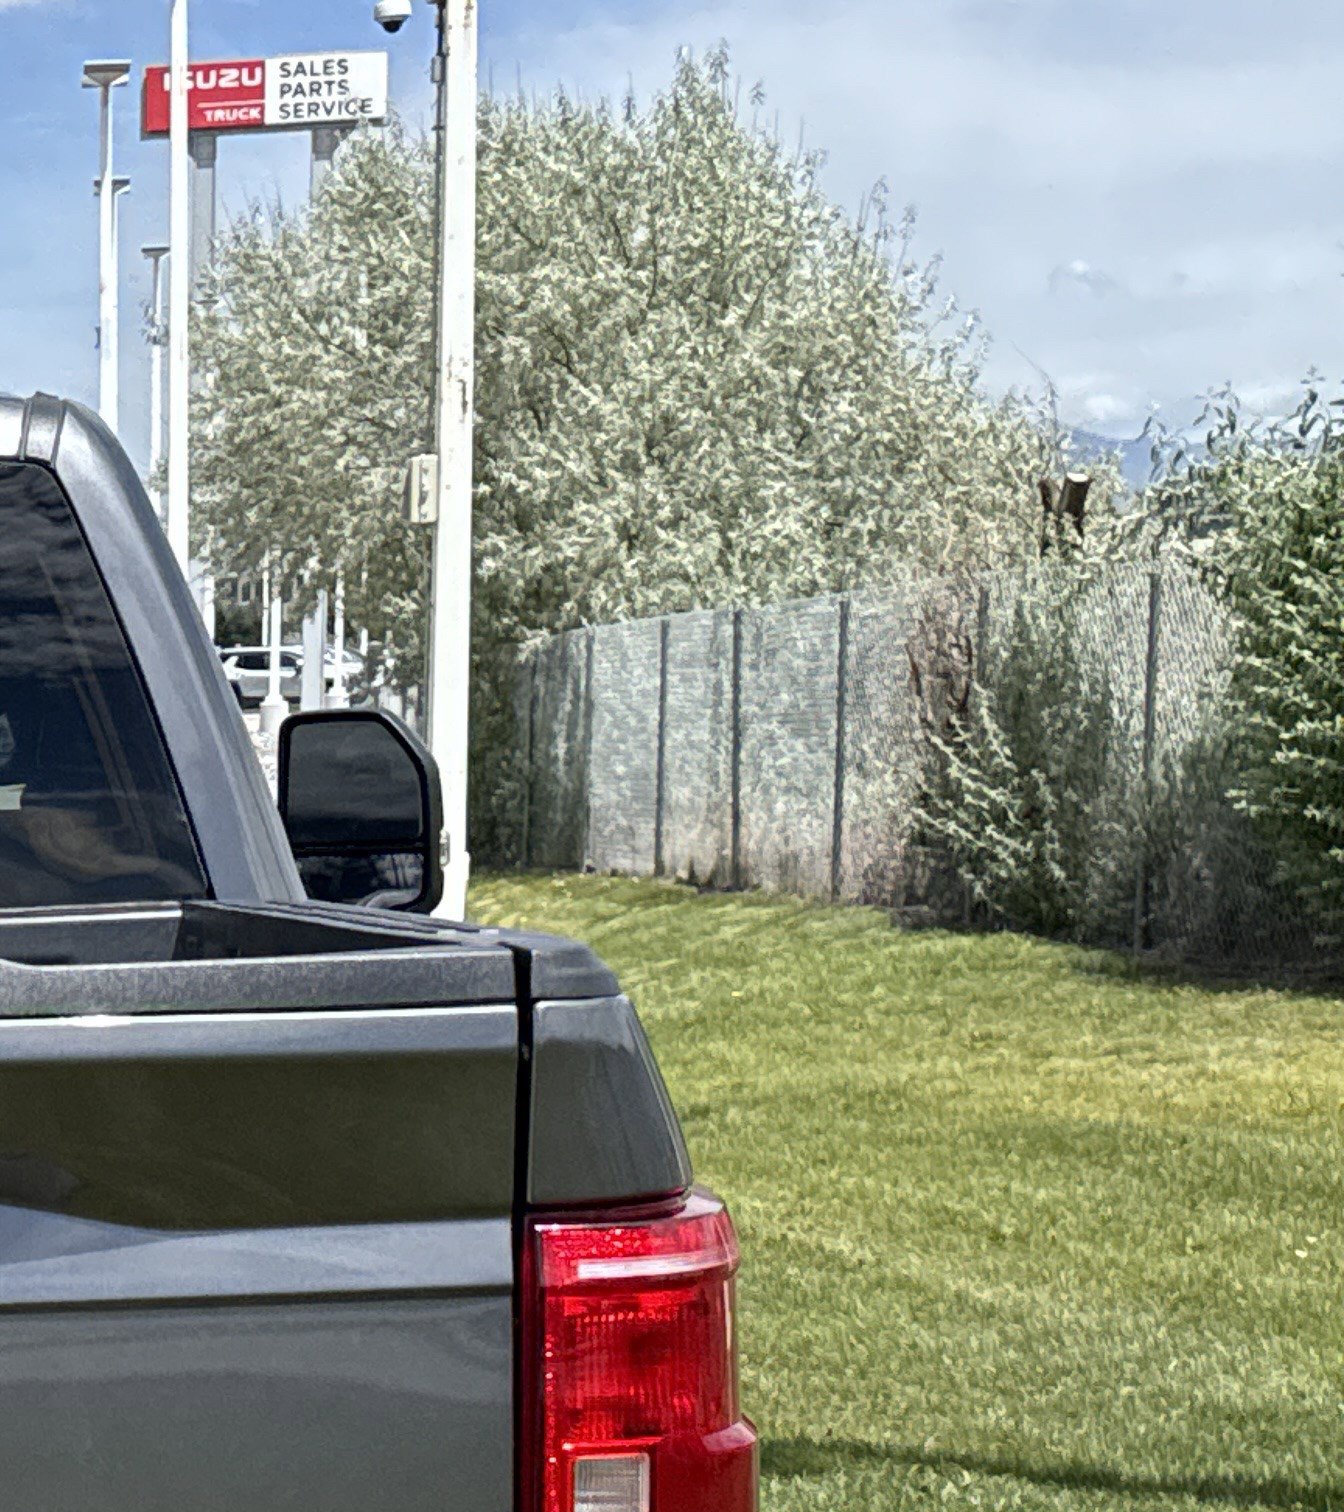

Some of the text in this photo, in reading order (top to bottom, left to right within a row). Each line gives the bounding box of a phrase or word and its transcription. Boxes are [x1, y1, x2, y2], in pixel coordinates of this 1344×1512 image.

[279, 58, 349, 79] SALES
[279, 79, 350, 99] PARTS
[203, 106, 261, 122] TRUCK
[278, 97, 374, 120] SERVICE
